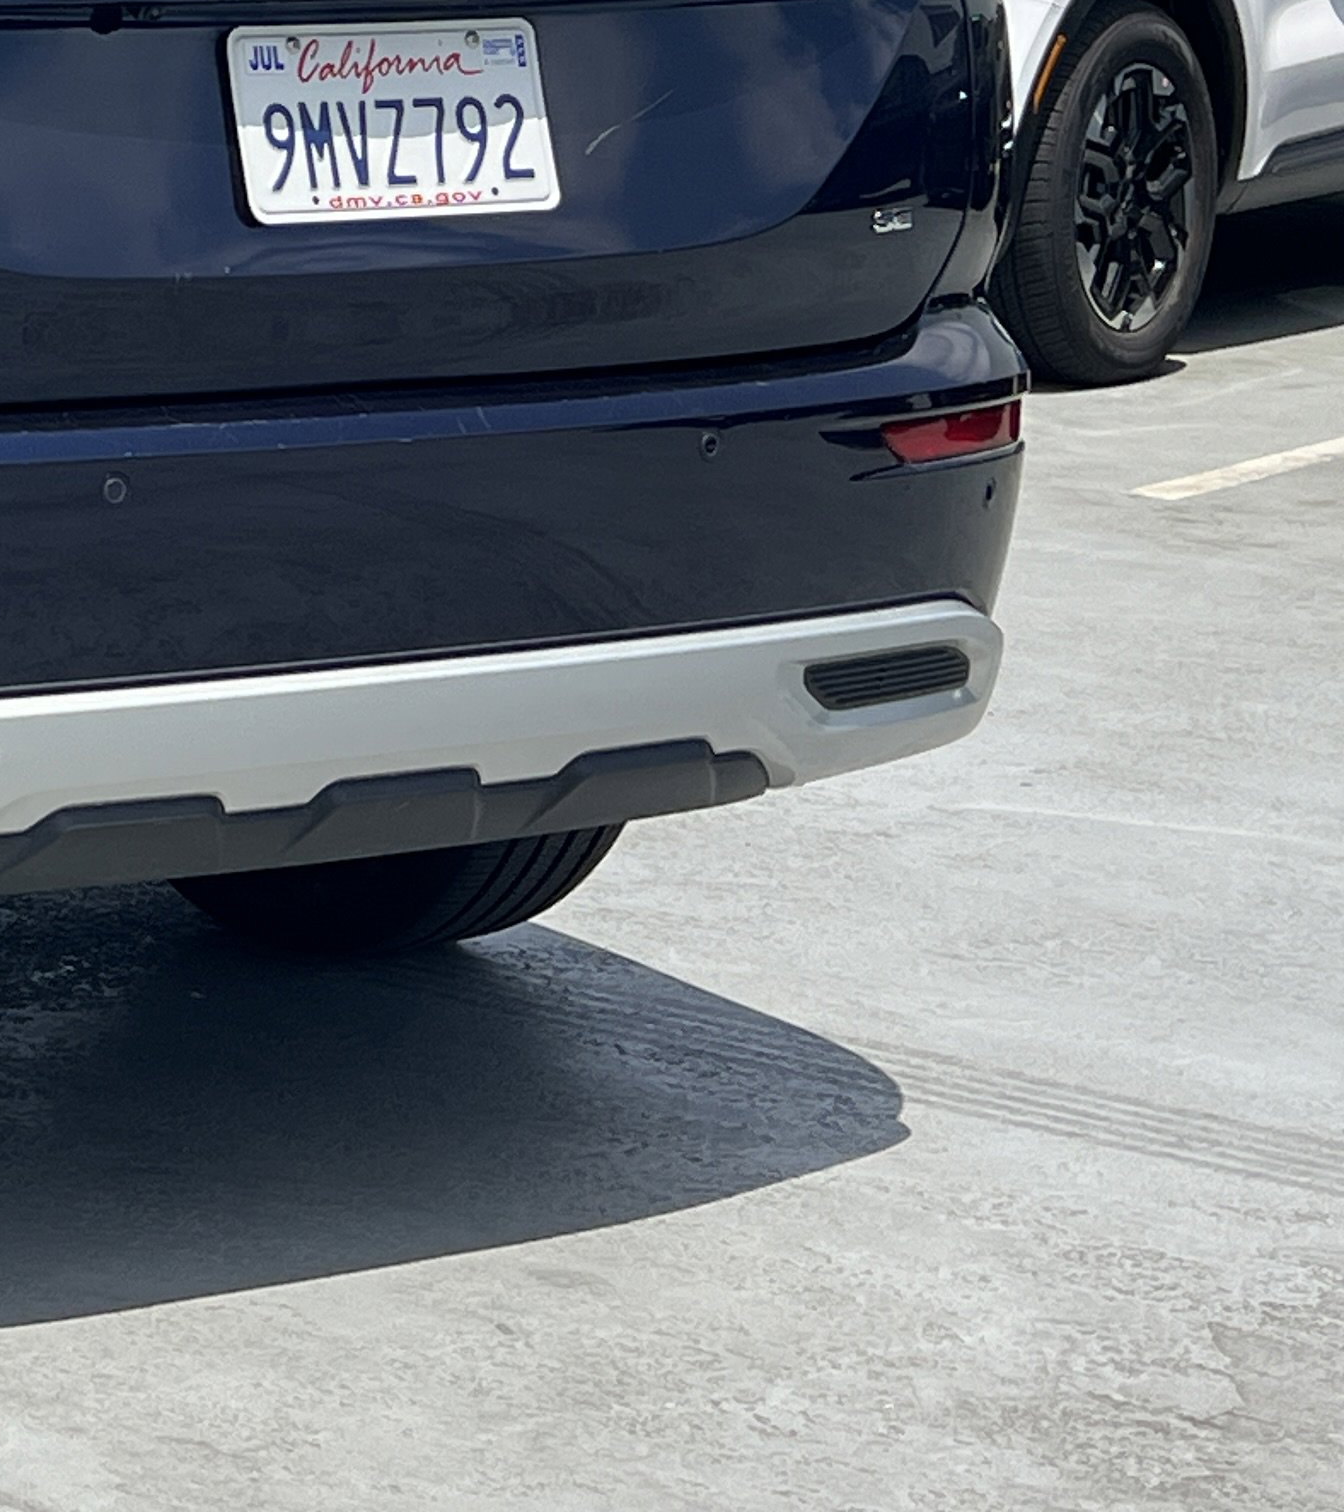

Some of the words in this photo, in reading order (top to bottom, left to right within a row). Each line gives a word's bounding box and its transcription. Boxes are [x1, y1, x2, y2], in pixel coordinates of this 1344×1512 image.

[249, 45, 285, 71] JUL
[297, 38, 484, 94] California
[263, 93, 535, 193] 9MVZ792
[328, 189, 483, 210] dmv.ca.gov
